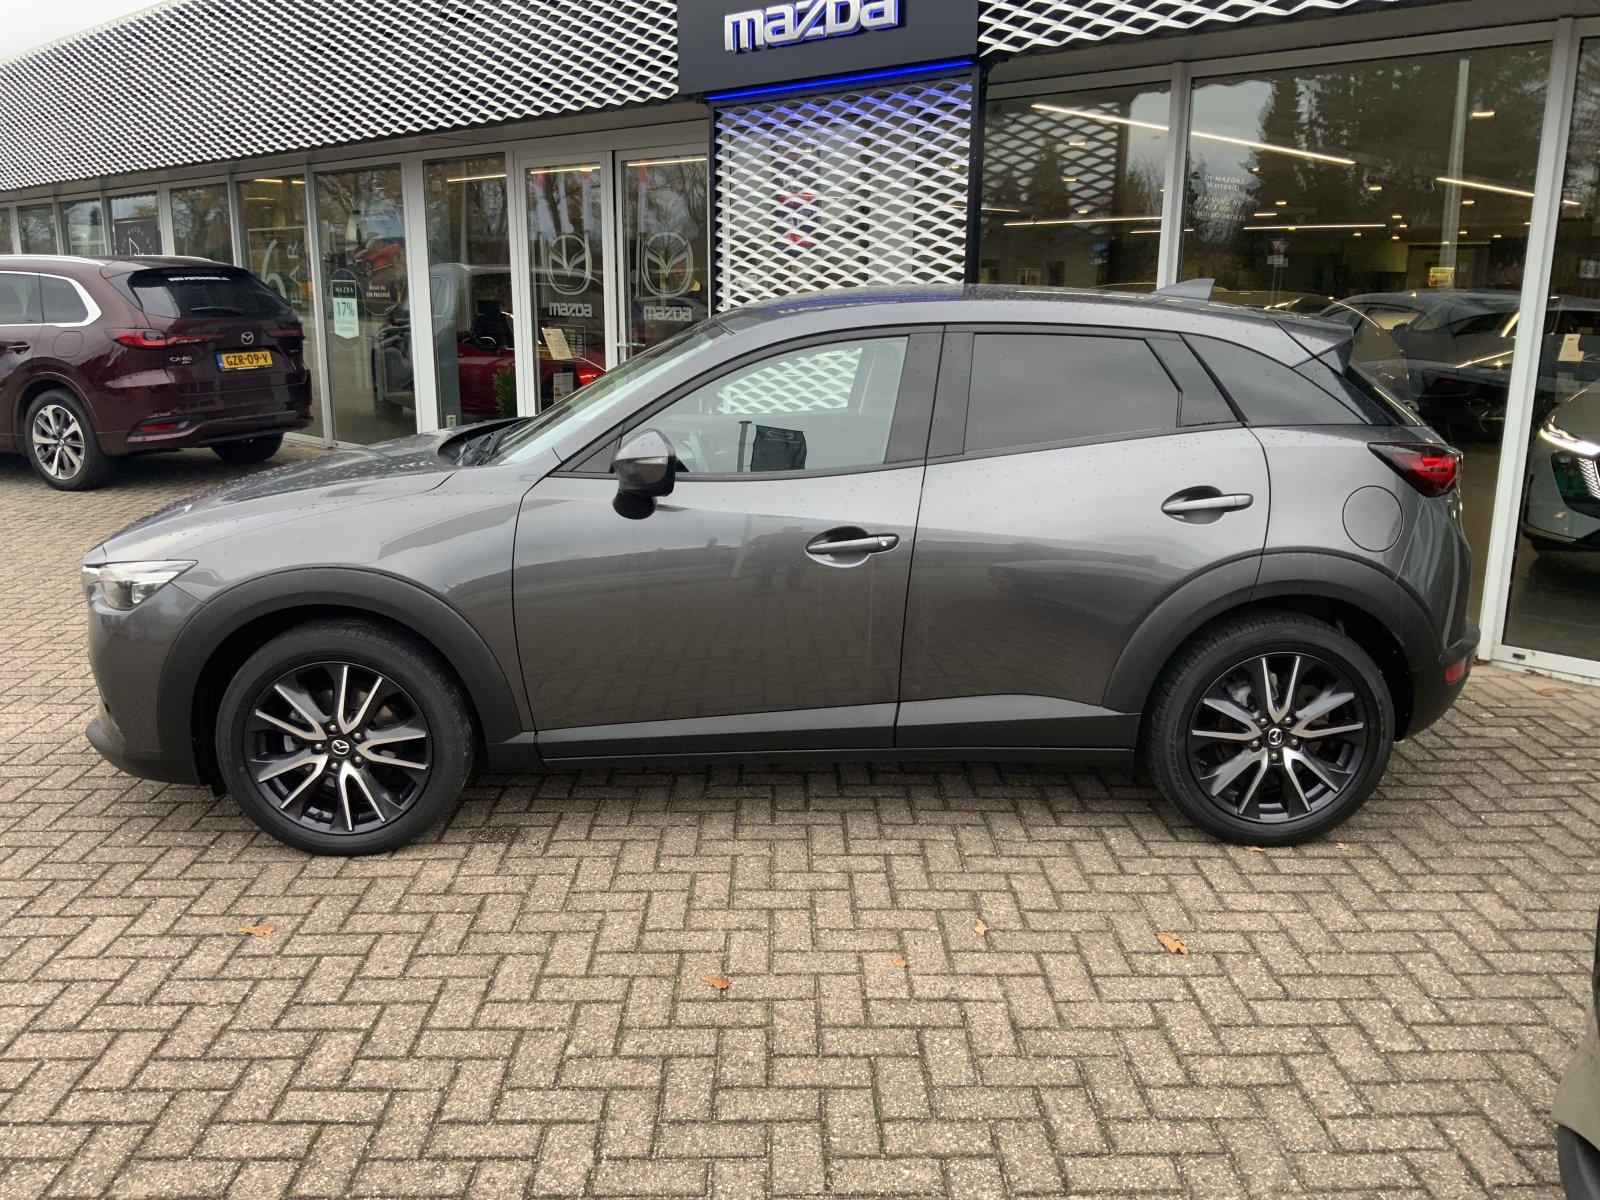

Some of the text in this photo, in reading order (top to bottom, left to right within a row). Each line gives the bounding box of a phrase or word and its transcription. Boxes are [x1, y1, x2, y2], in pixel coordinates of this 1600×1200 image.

[724, 0, 898, 52] mazda
[335, 286, 354, 294] MAZDA
[336, 301, 355, 317] 17%
[225, 353, 268, 366] GZR-09-V
